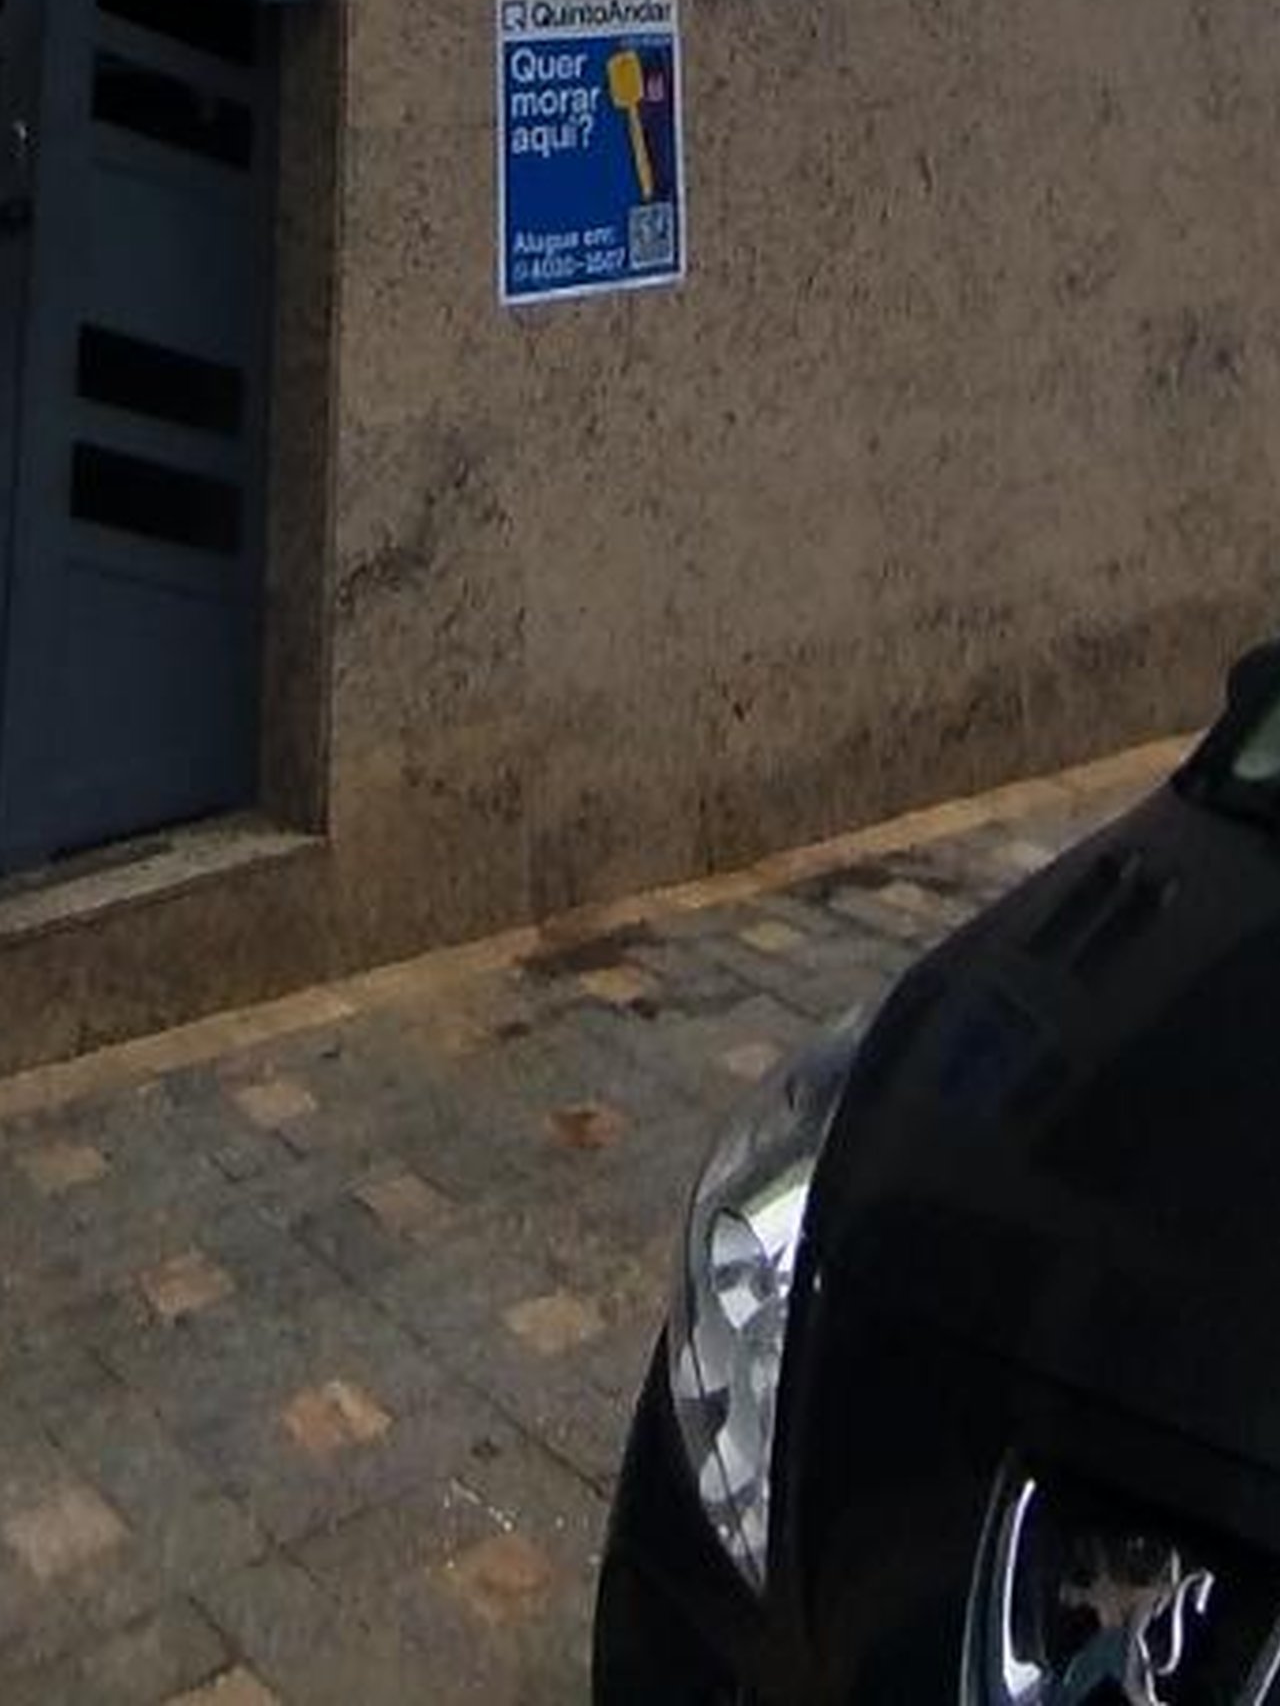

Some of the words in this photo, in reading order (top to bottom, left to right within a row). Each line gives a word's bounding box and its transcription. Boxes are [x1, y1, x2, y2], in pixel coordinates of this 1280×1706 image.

[511, 47, 588, 83] Quer
[511, 85, 601, 118] morar
[511, 114, 593, 158] aqui?
